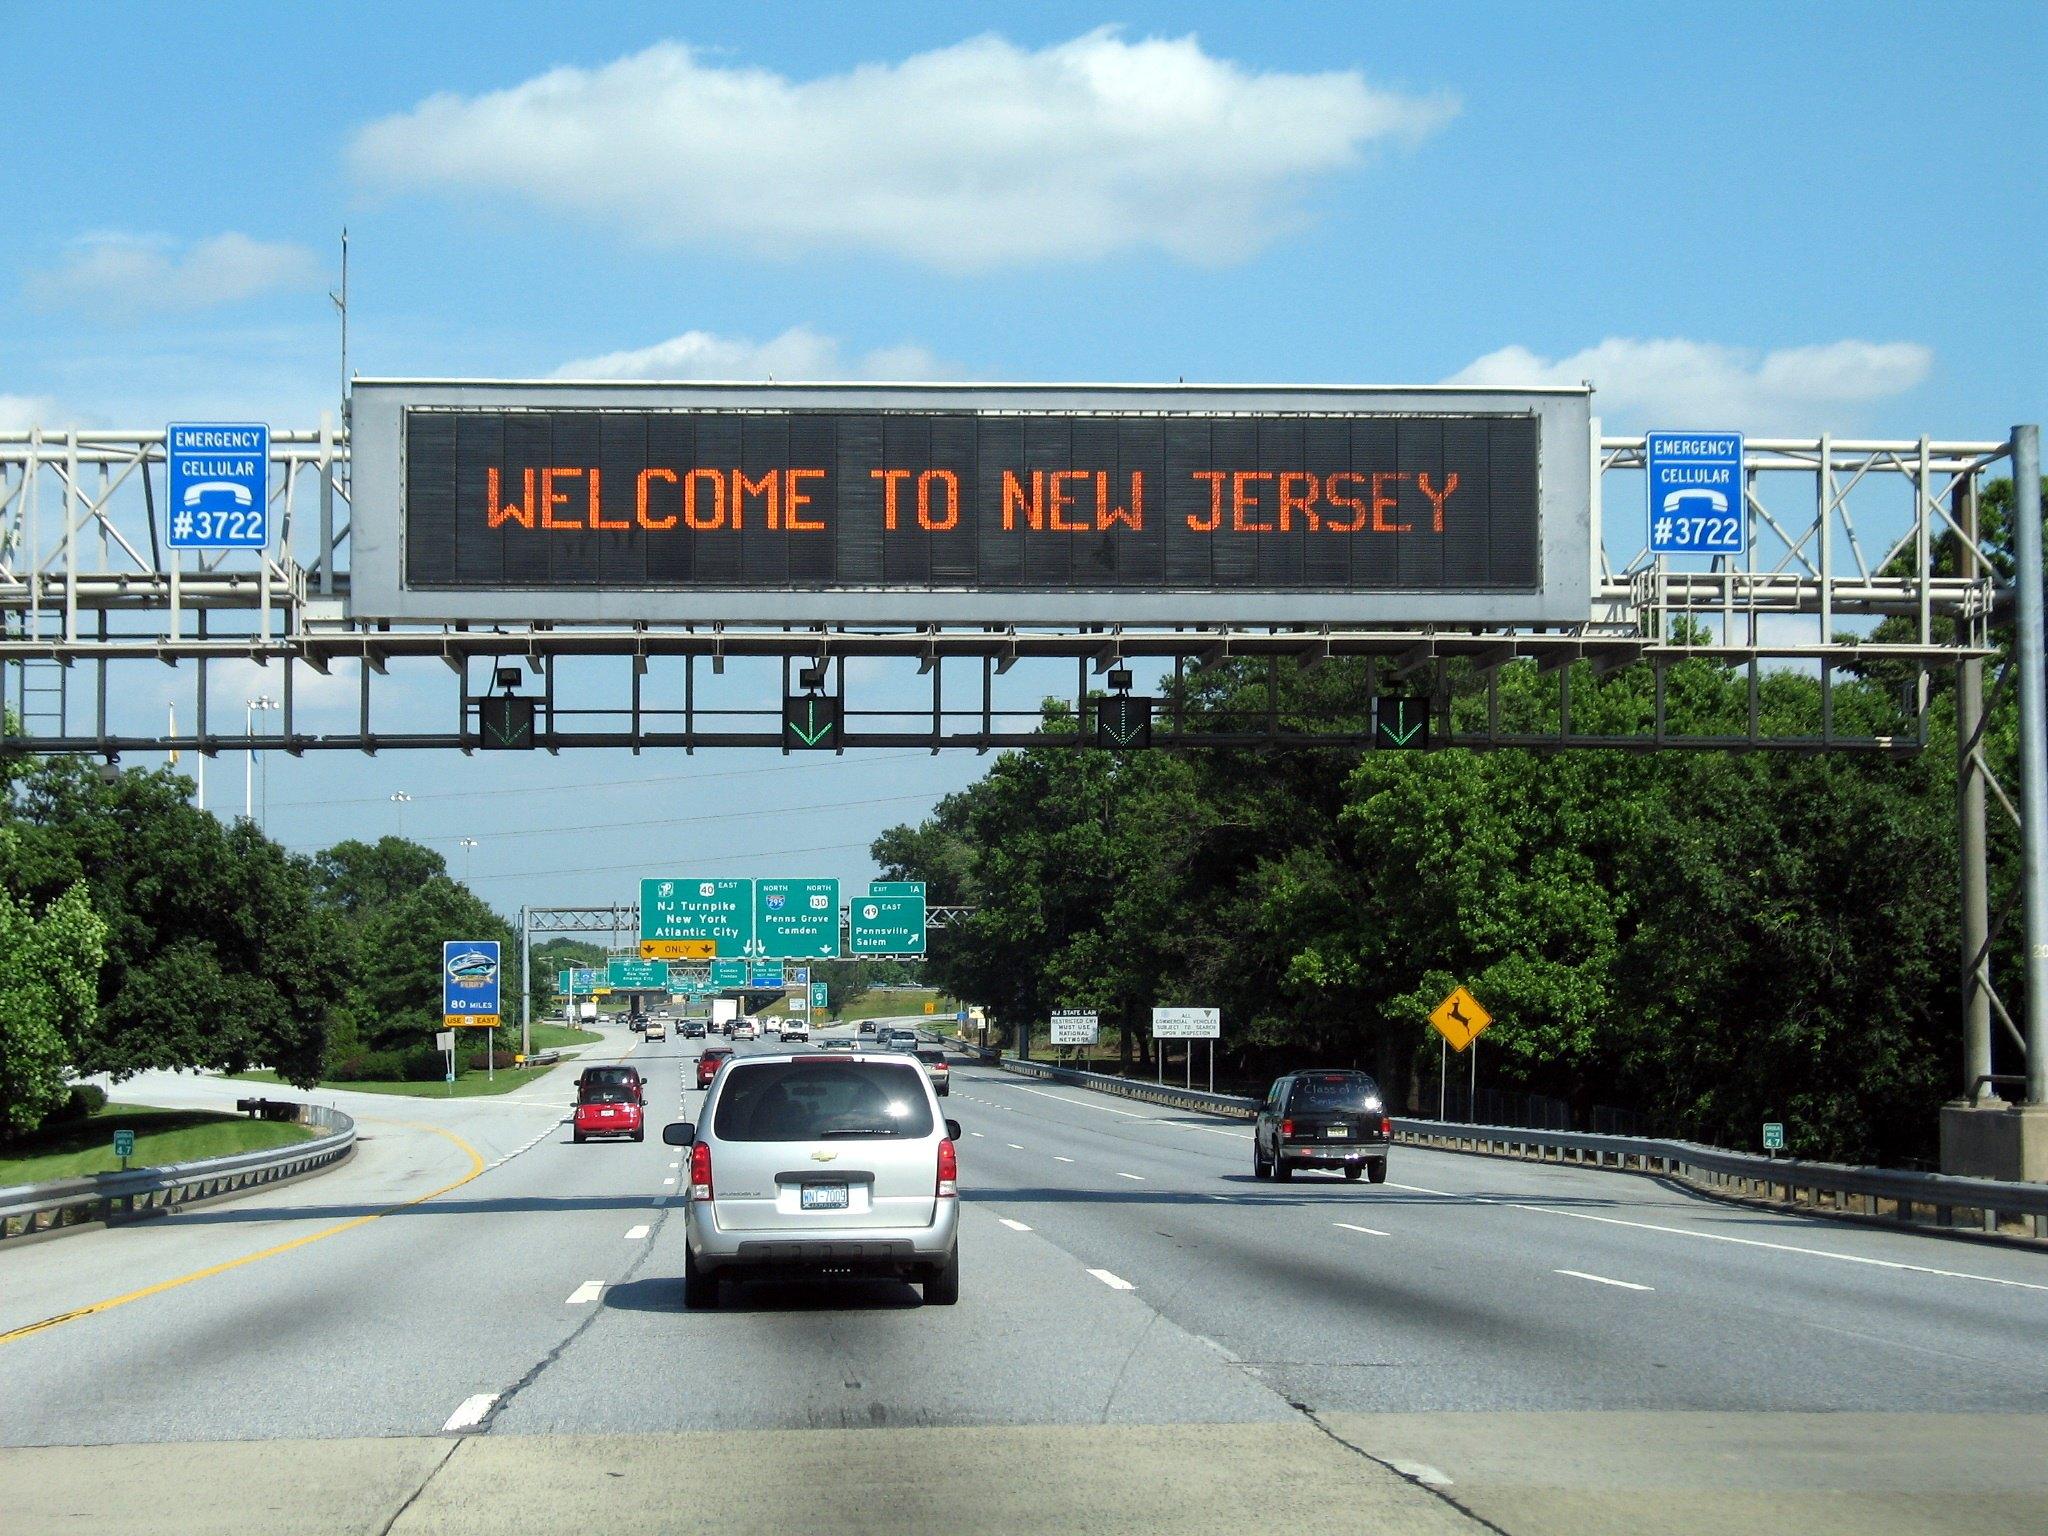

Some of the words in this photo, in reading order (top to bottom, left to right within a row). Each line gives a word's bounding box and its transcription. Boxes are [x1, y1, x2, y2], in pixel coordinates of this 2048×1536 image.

[176, 431, 260, 447] EMERGENCY
[1654, 440, 1735, 455] EMERGENCY
[182, 461, 254, 476] CELLULAR
[1661, 468, 1730, 483] CELLULAR
[488, 467, 826, 530] WELCOME
[870, 469, 960, 531] TO
[1002, 470, 1144, 532] NEW
[1187, 472, 1460, 533] JERSEY
[173, 510, 263, 539] #3722
[1654, 517, 1739, 545] #3722
[701, 885, 714, 894] 40
[657, 902, 674, 911] NJ
[681, 901, 736, 912] Turnpike
[767, 899, 785, 907] 295
[811, 898, 827, 907] 130
[864, 907, 877, 916] 49
[666, 914, 692, 923] New
[699, 914, 727, 923] York
[765, 915, 796, 923] Penns
[801, 915, 829, 923] Grove
[655, 926, 707, 937] Atlantic
[713, 927, 739, 938] City
[777, 926, 817, 934] Camden
[856, 927, 909, 935] Pennsville
[856, 937, 887, 946] Salem
[664, 945, 691, 953] ONLY
[451, 1000, 466, 1009] 80
